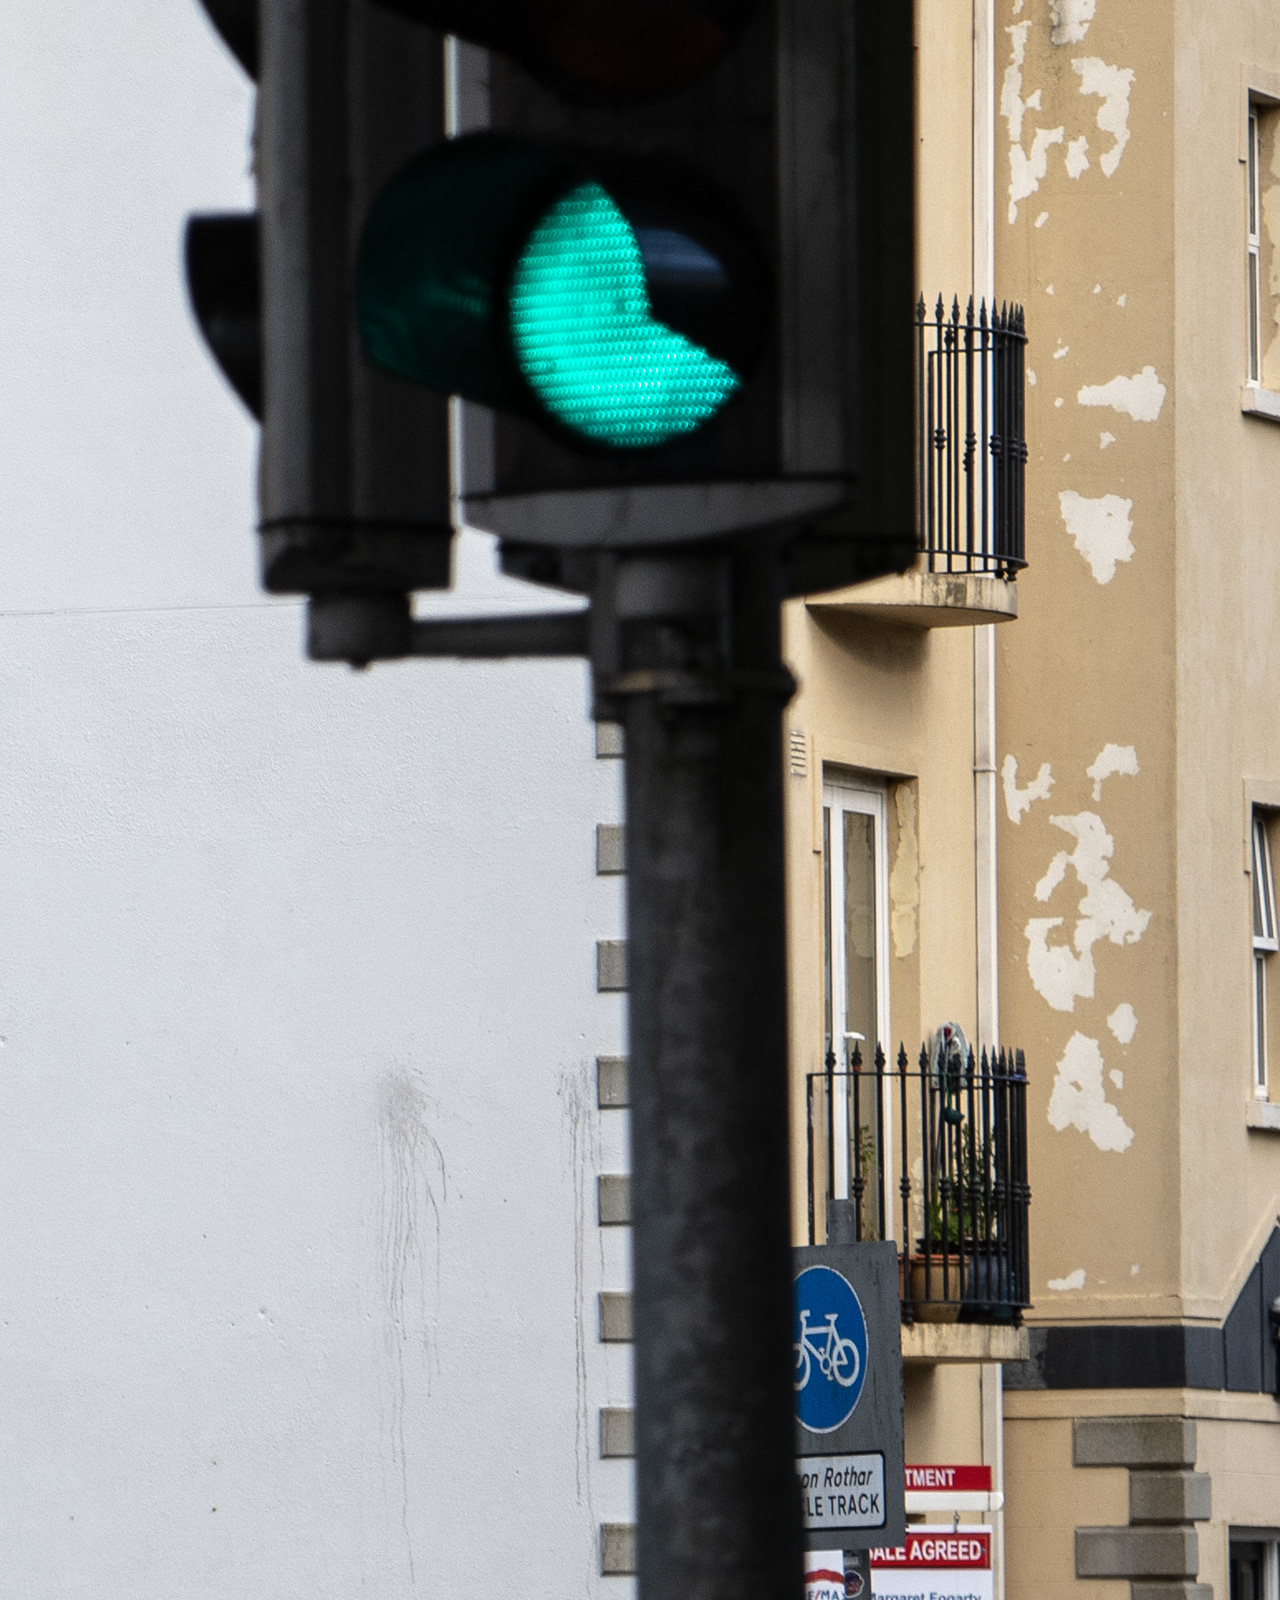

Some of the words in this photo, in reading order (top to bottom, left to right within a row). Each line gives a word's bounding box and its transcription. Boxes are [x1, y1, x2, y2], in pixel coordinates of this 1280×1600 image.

[824, 1466, 873, 1488] Rothar
[905, 1469, 955, 1487] TMENT
[829, 1493, 880, 1516] TRACK
[910, 1540, 981, 1561] AGREED
